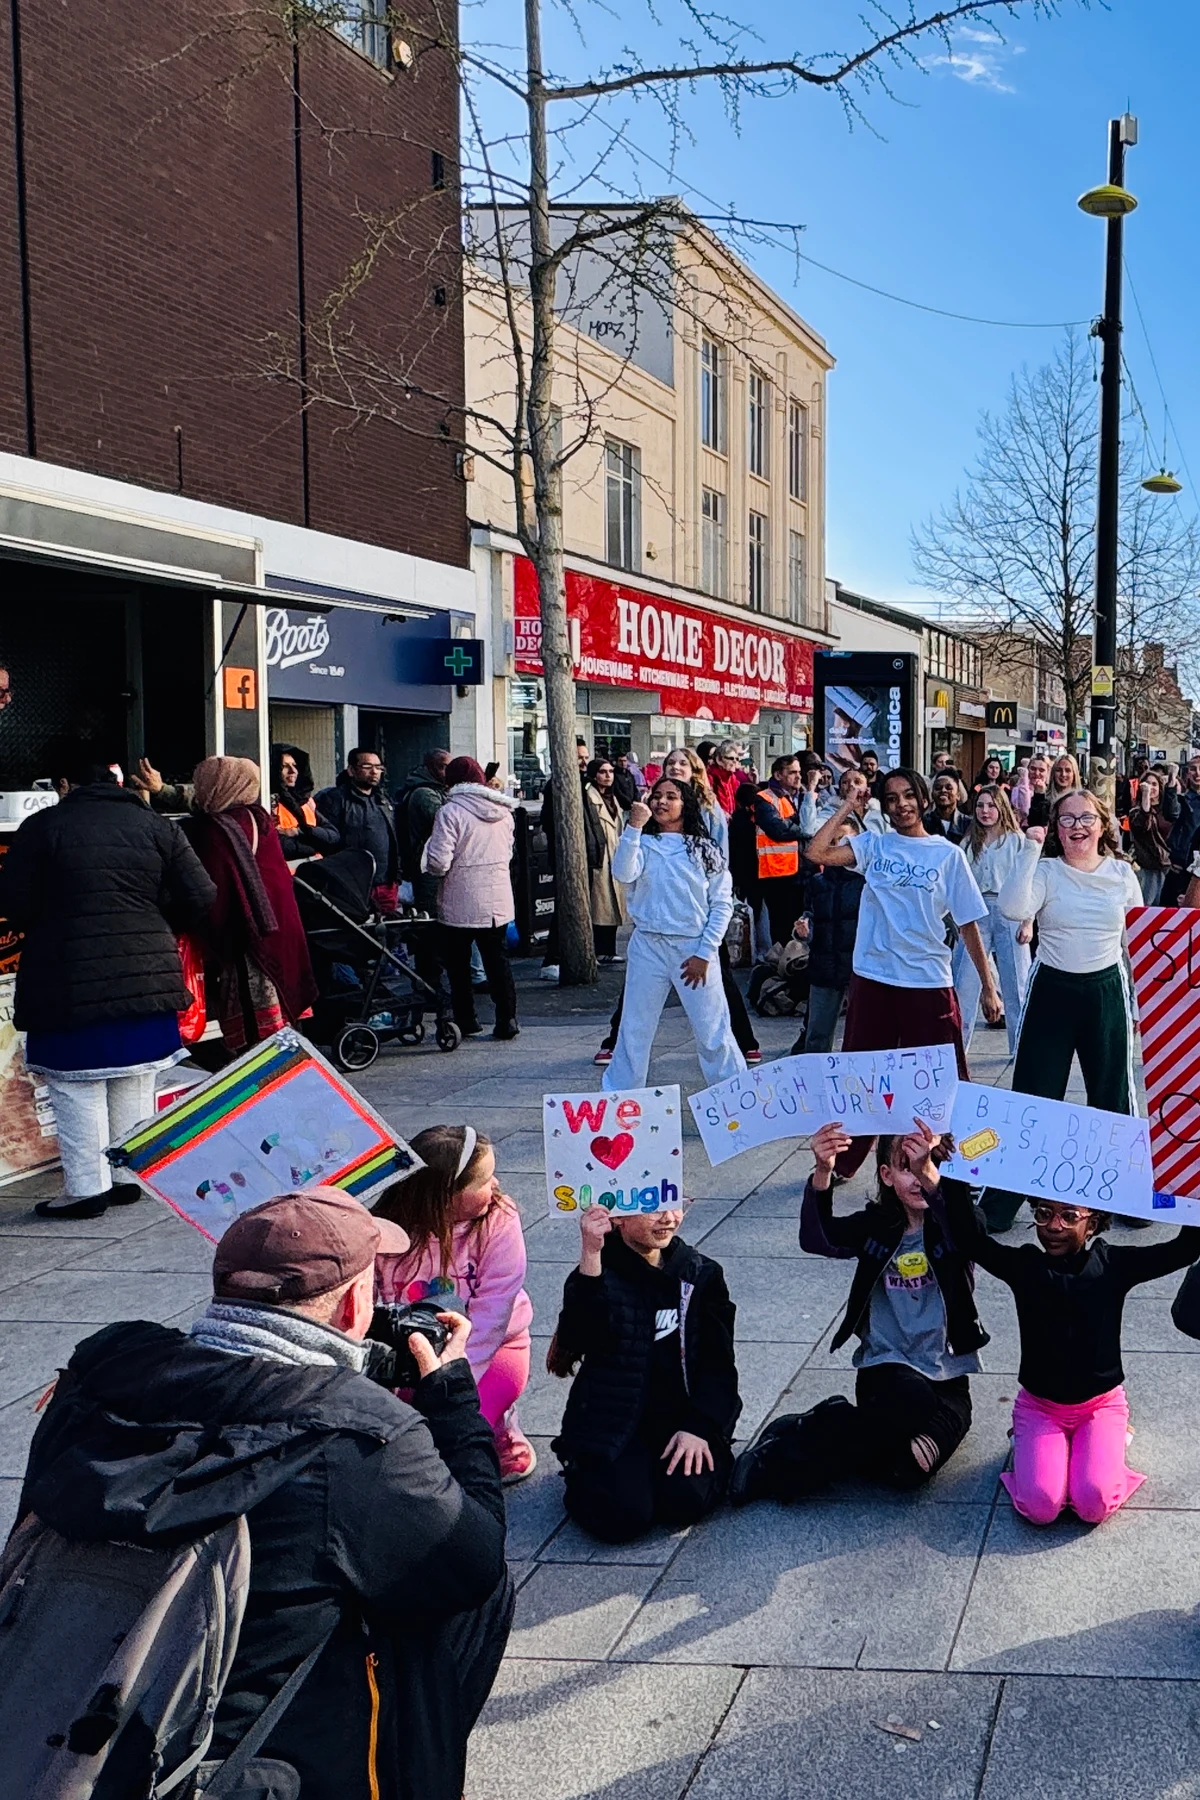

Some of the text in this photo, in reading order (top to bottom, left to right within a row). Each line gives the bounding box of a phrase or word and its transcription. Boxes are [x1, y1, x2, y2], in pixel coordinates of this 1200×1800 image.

[265, 608, 330, 670] Boots
[519, 620, 542, 635] HO
[616, 598, 787, 687] HOME DECOR
[309, 663, 328, 675] Since
[581, 656, 633, 680] HOUSEWARE
[639, 666, 690, 690] KITCHENWARE
[724, 682, 761, 701] ELECTRONICS
[873, 858, 940, 882] CHICAGO
[562, 1098, 641, 1134] We
[706, 1067, 944, 1126] SLOUGH TOWN OF
[977, 1094, 1038, 1128] BIG
[1018, 1129, 1145, 1175] SLOUGH
[1030, 1156, 1119, 1201] 2028
